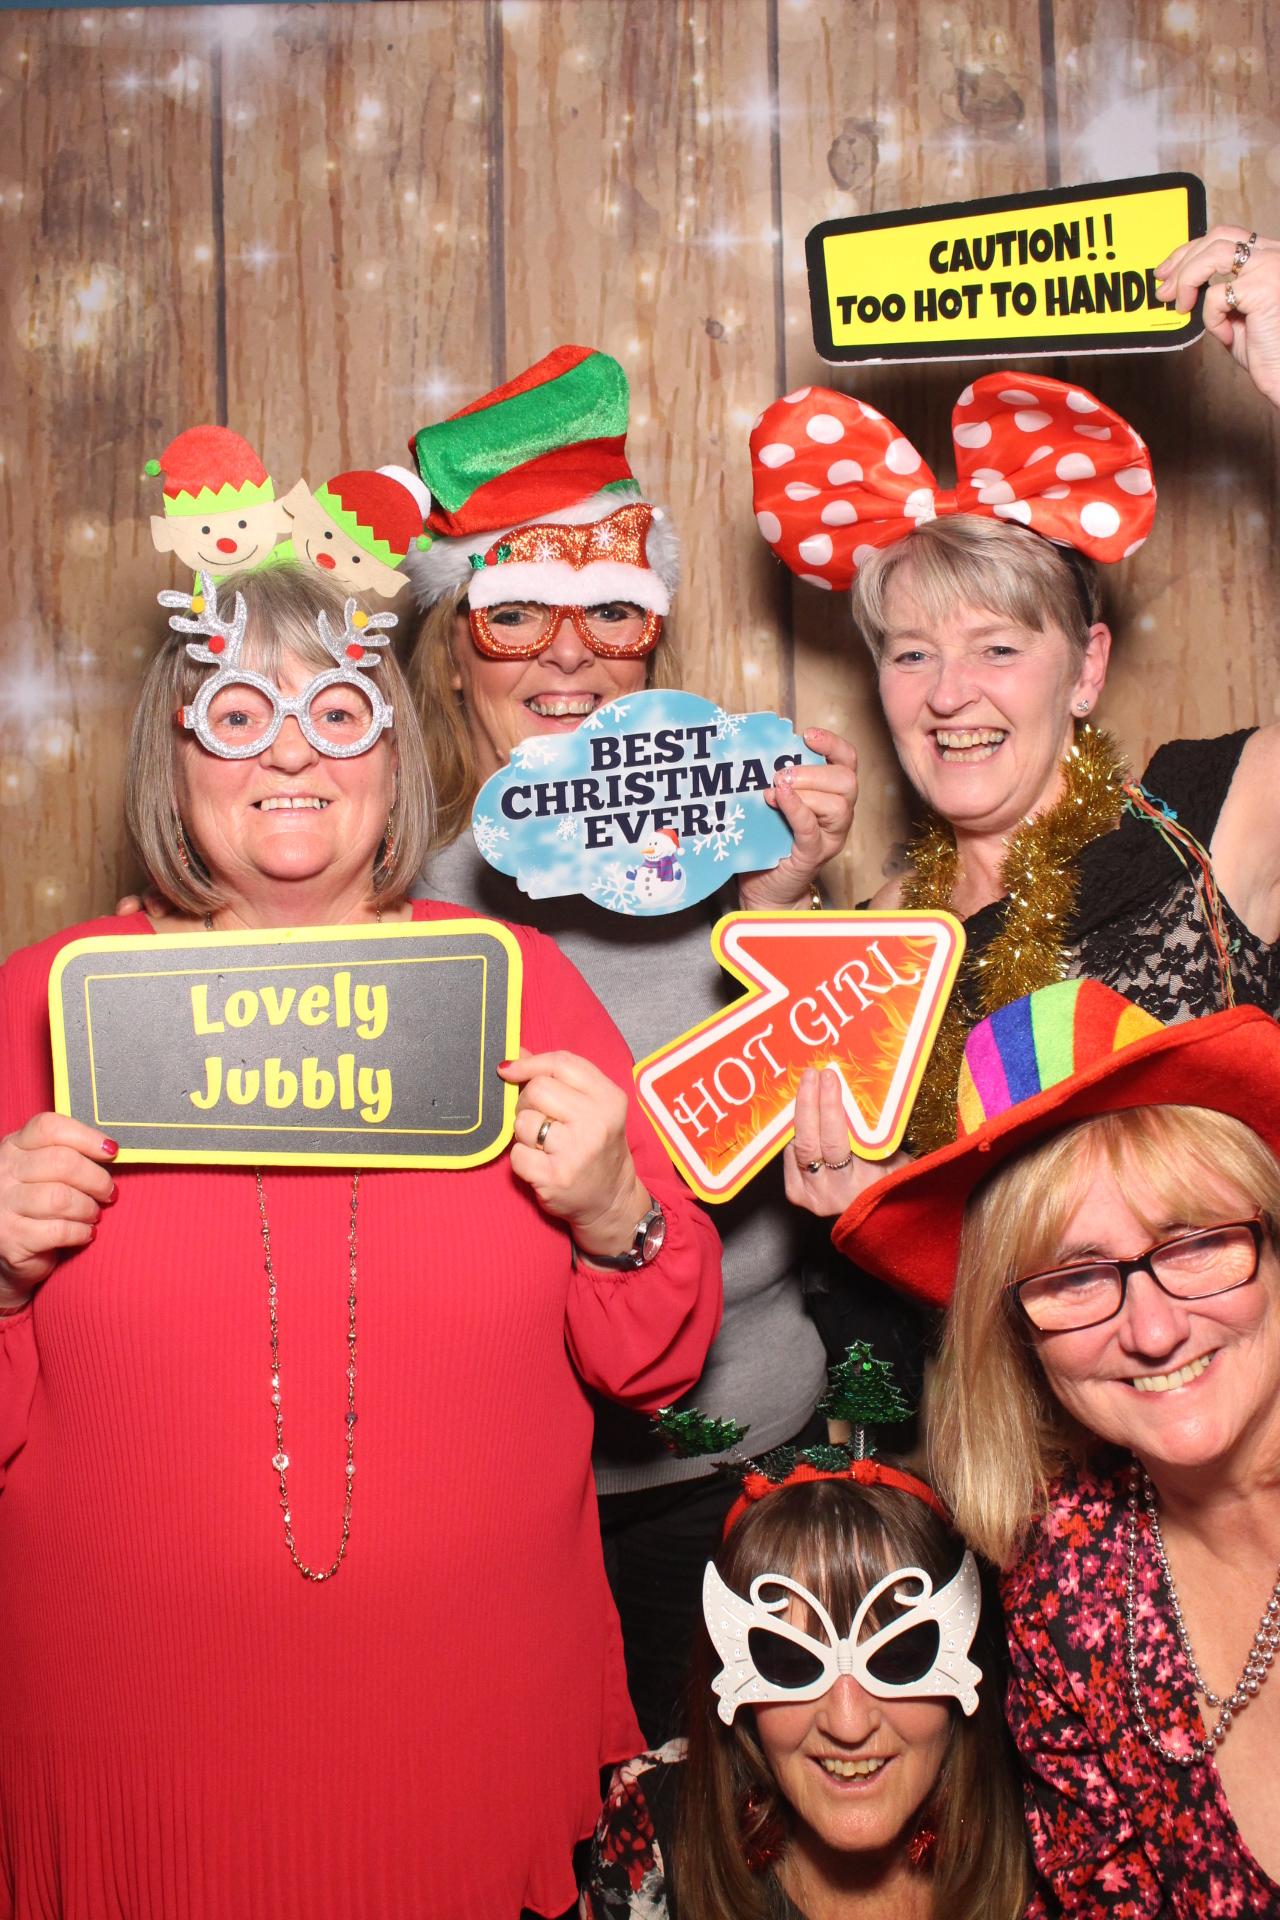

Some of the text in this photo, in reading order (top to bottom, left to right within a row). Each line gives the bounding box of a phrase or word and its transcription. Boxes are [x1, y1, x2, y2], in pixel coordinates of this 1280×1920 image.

[929, 213, 1116, 275] CAUTION!!
[836, 267, 1178, 325] TOO HOT TO HANDL
[590, 724, 717, 772] BEST
[584, 800, 727, 850] EVER!
[190, 971, 389, 1040] Lovely
[673, 940, 921, 1138] HOT GIRL
[189, 1053, 393, 1124] Jubbly
